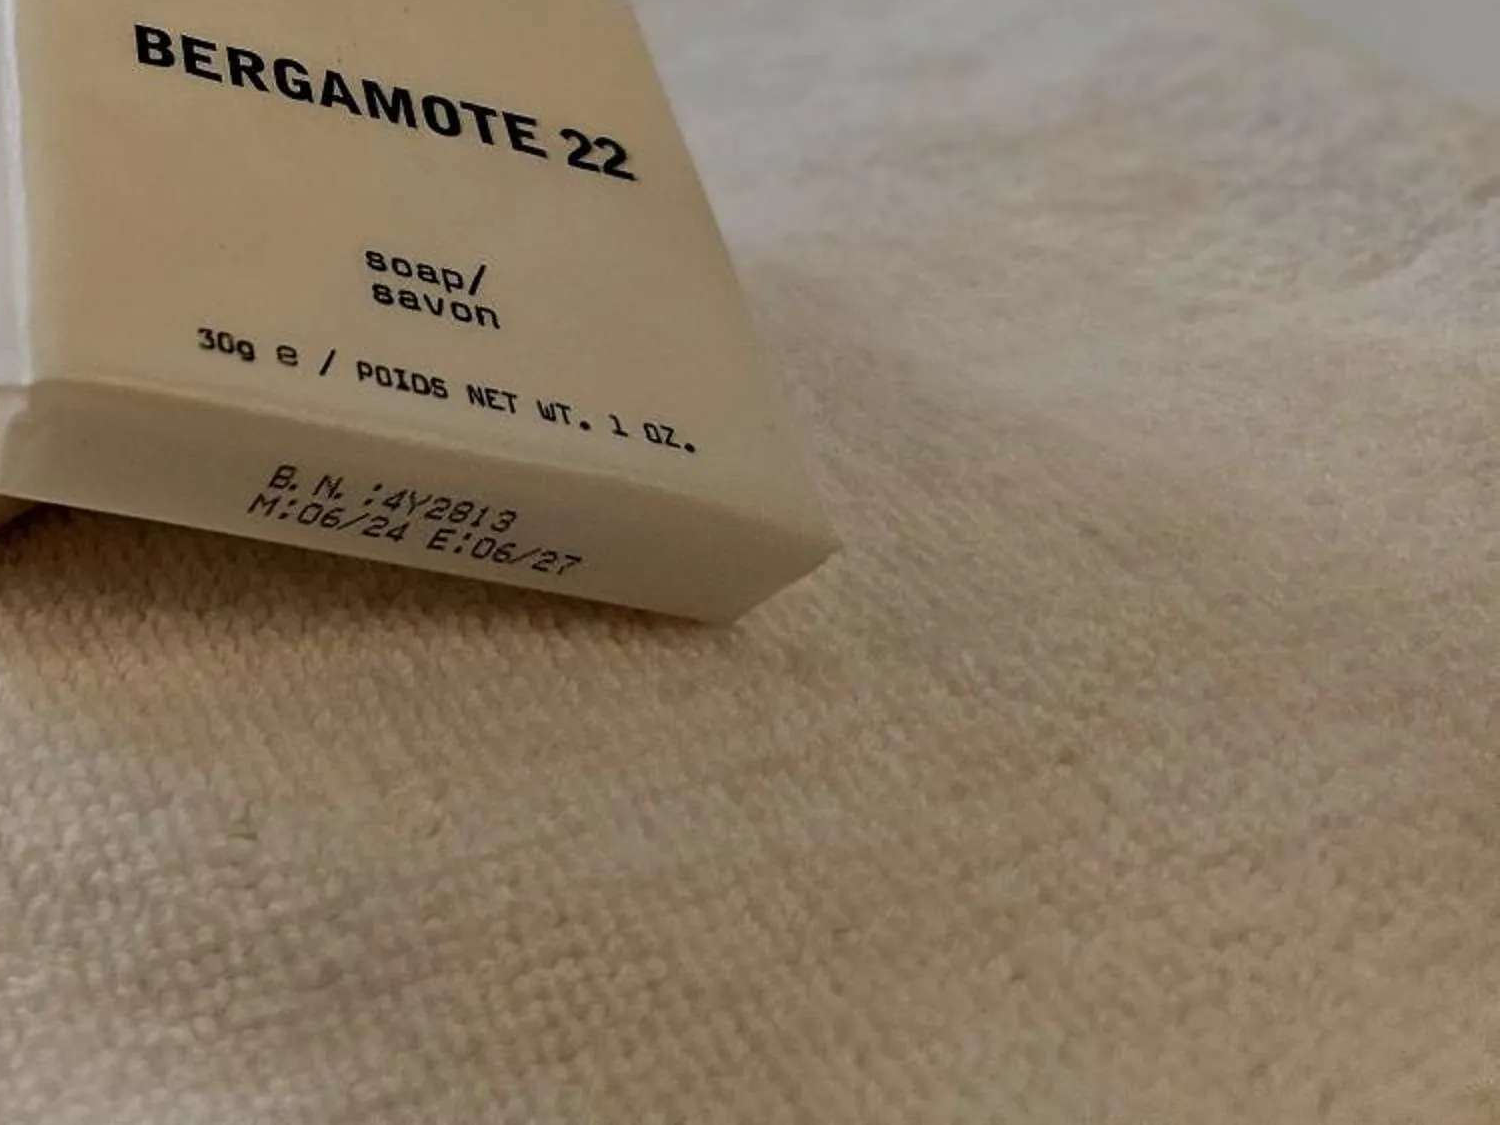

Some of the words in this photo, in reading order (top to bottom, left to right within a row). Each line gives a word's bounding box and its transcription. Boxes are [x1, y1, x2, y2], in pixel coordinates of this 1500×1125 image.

[134, 25, 548, 158] BERGAMOTE
[560, 128, 637, 182] 22
[365, 250, 486, 296] soap/
[372, 282, 500, 329] savon
[198, 328, 255, 362] 30g
[356, 360, 448, 400] POIDS
[467, 383, 518, 414] NET
[537, 400, 591, 431] WT.
[610, 415, 629, 437] 1
[644, 422, 697, 454] OZ.
[268, 465, 298, 491] B.
[247, 493, 412, 543] M:06/24
[426, 527, 583, 575] E:06/27
